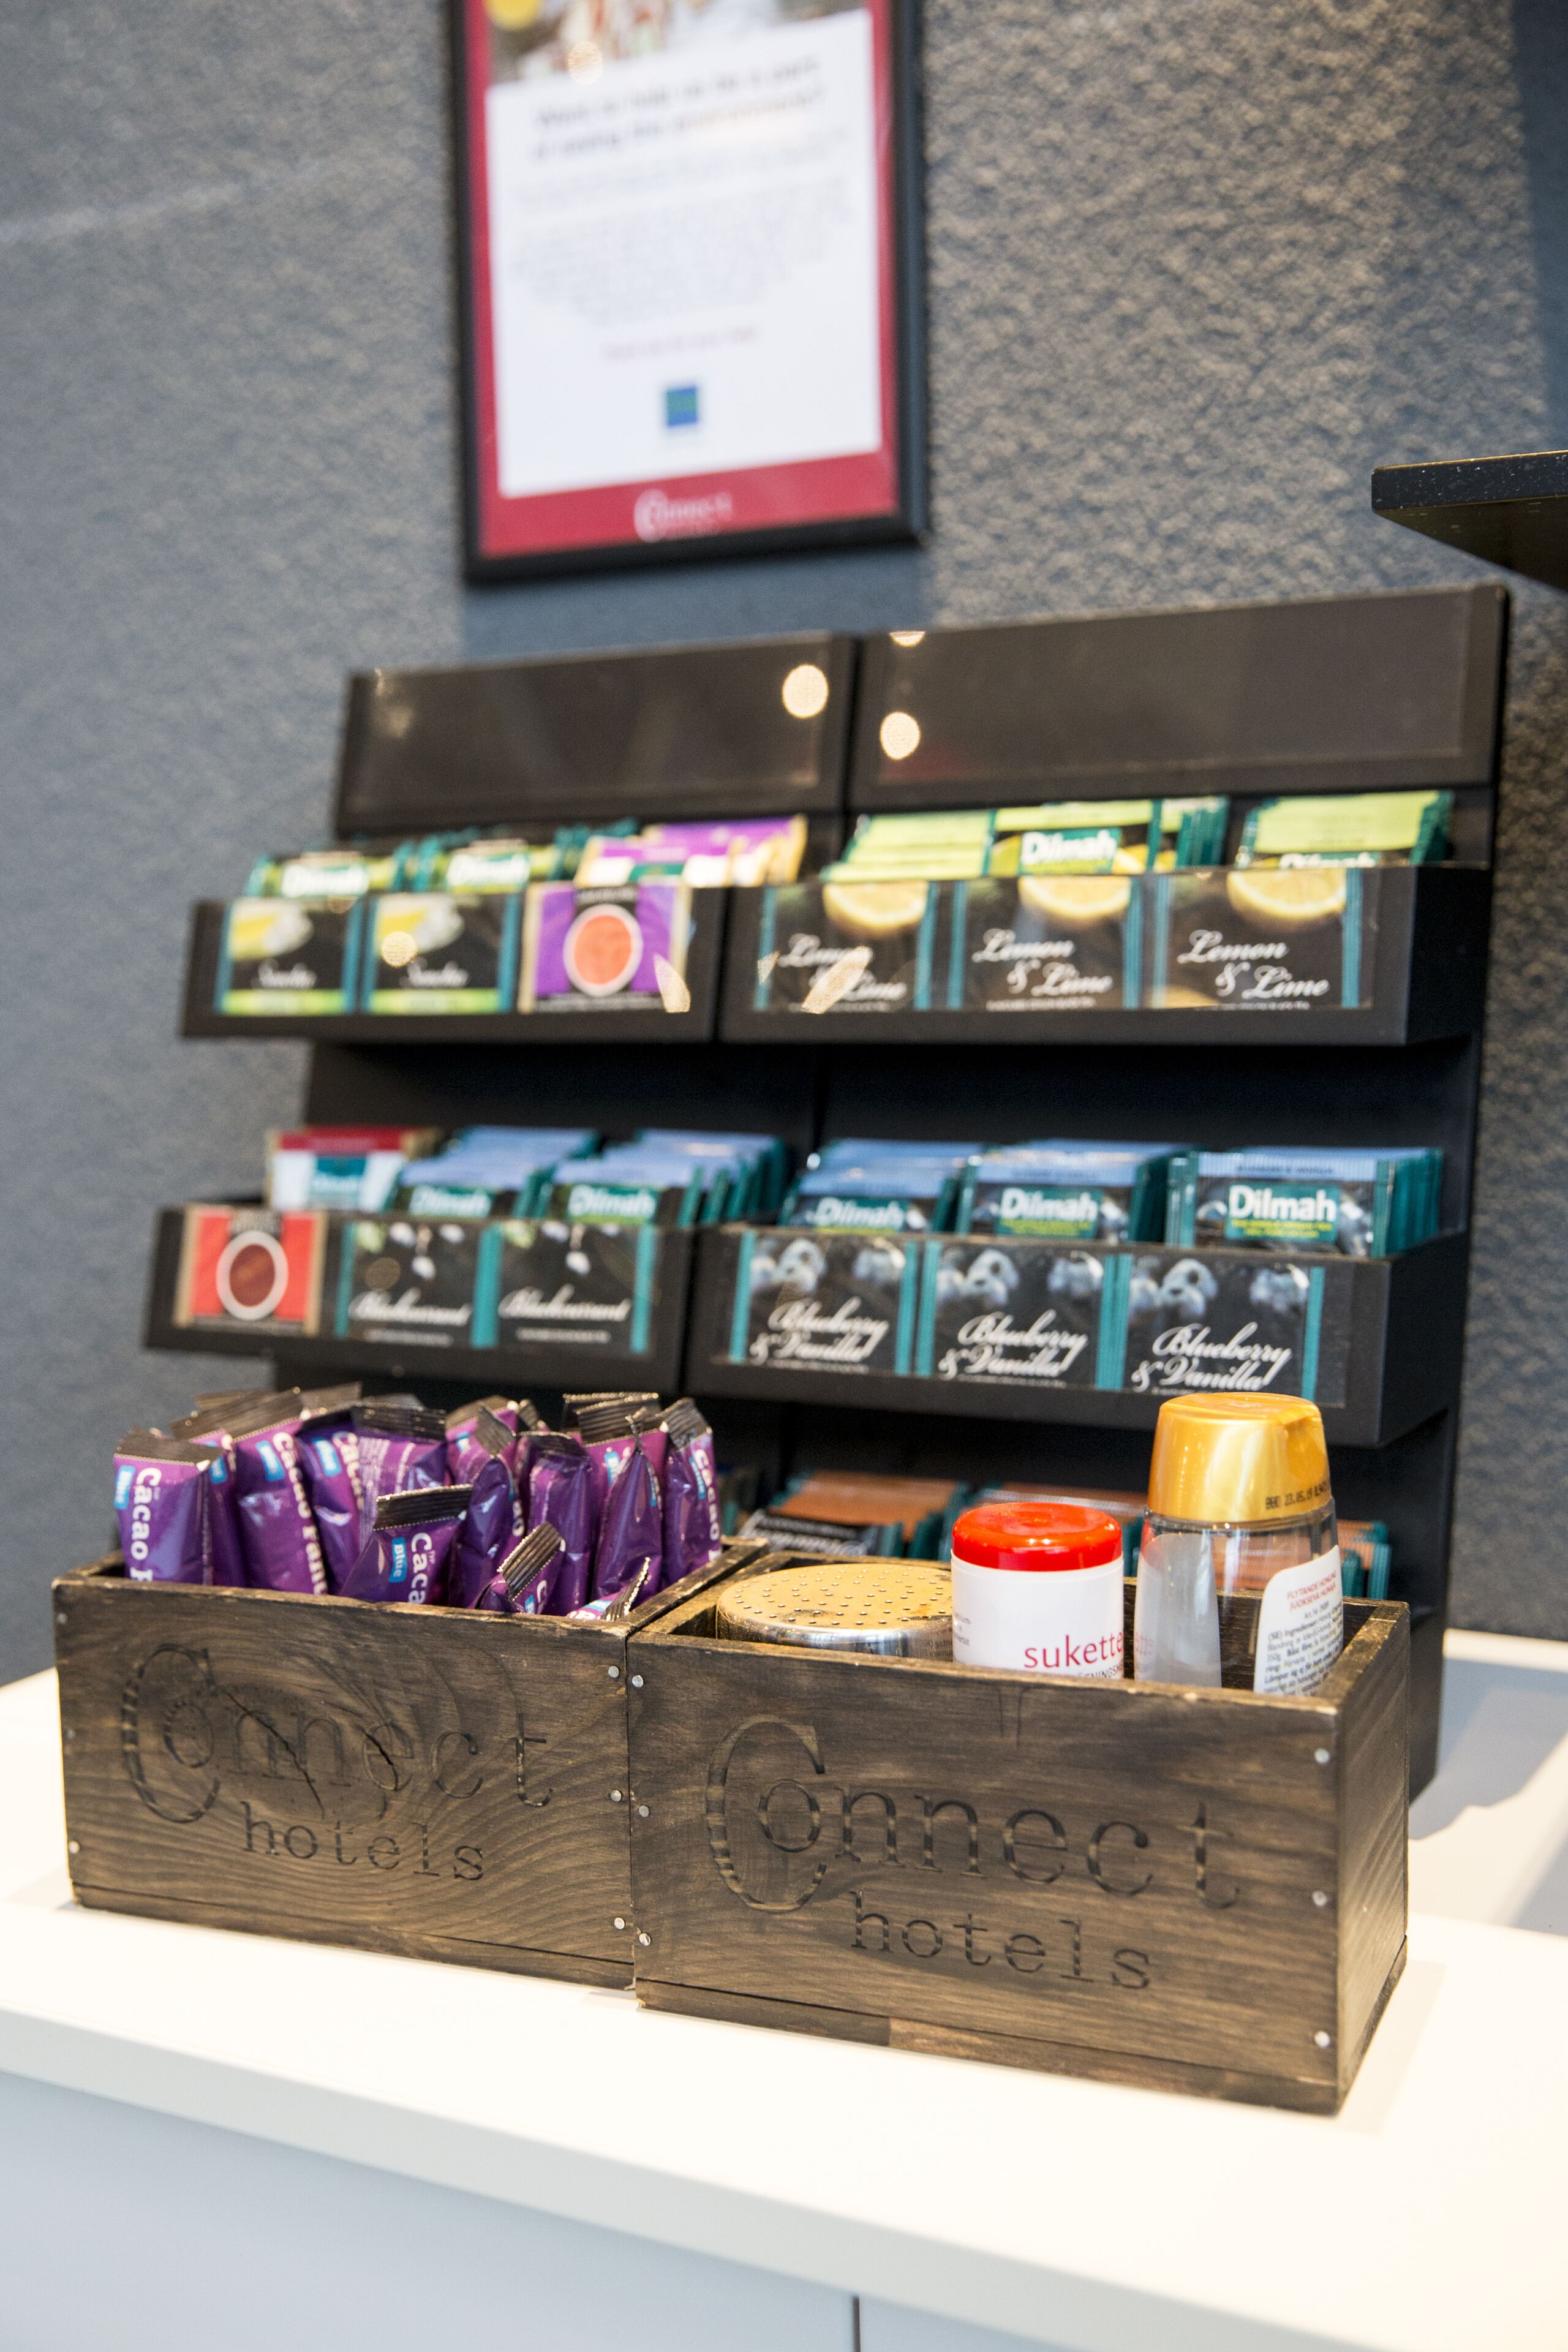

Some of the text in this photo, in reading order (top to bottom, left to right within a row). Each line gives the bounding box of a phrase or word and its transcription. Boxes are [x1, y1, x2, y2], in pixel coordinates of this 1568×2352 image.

[1021, 829, 1117, 865] Dilmah
[777, 932, 872, 968] Lem
[971, 927, 1075, 963] Lemon
[1177, 929, 1288, 965] Lemon
[1030, 962, 1114, 997] Lime
[1214, 962, 1330, 1000] & Lime
[815, 1196, 905, 1230] Dilmah
[1000, 1187, 1099, 1223] Dilmah
[1229, 1184, 1338, 1223] Dilmah
[957, 1308, 1089, 1372] Blueberry
[1152, 1321, 1293, 1386] Blueberry
[1131, 1354, 1264, 1393] & Vanilla
[130, 1467, 162, 1561] Cacao
[393, 1543, 406, 1578] Blue
[408, 1532, 432, 1604] Caca
[1023, 1632, 1123, 1668] sukette
[123, 1643, 553, 1824] Connect
[704, 1715, 1241, 1914] Connect
[240, 1801, 485, 1882] hotels
[850, 1890, 1152, 1989] hotels
